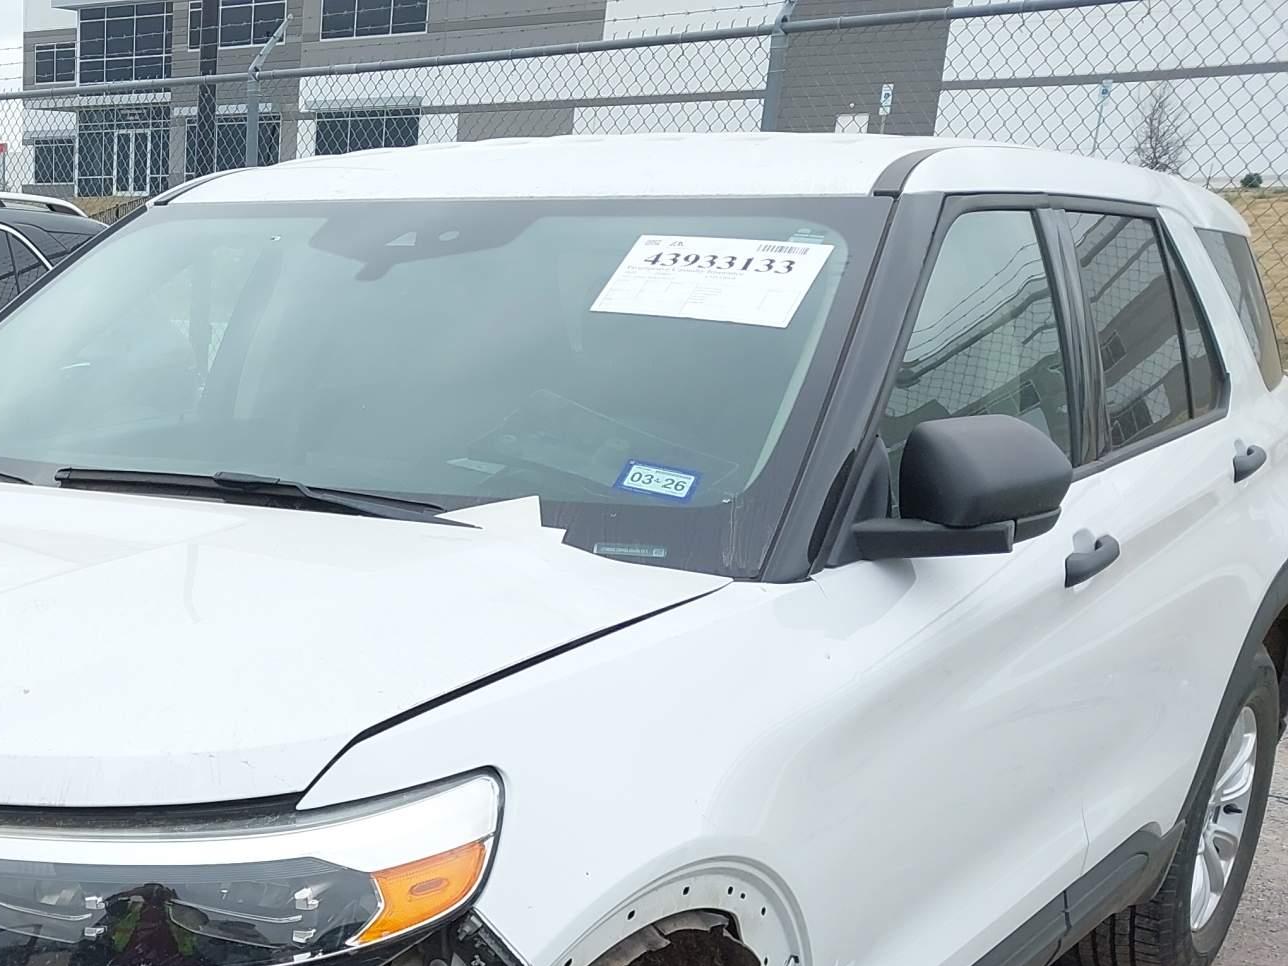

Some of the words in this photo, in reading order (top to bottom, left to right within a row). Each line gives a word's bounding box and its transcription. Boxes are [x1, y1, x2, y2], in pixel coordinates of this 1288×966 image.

[644, 251, 796, 275] 43933133
[630, 471, 654, 485] 03
[661, 478, 687, 492] 26
